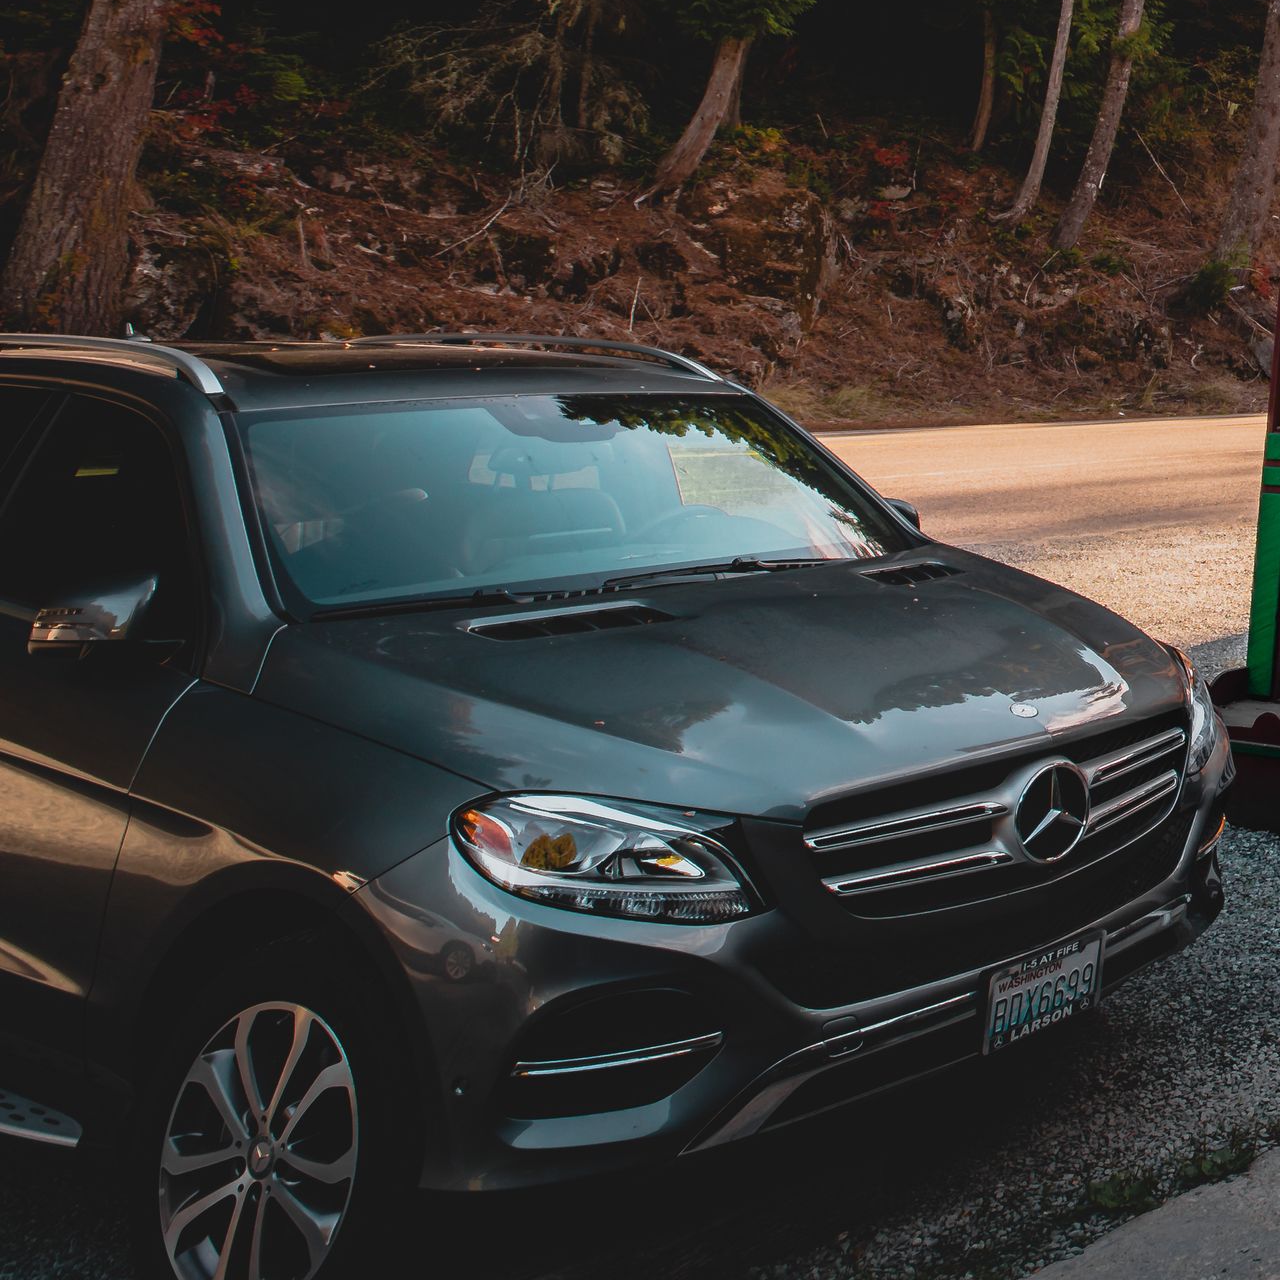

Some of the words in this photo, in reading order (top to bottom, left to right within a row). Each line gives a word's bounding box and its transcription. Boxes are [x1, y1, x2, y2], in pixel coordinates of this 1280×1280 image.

[1023, 959, 1037, 971] I-5
[1039, 952, 1055, 964] AT
[1057, 941, 1080, 959] FIFE
[998, 960, 1063, 993] WASHINGTON
[1010, 1004, 1073, 1042] LARSON
